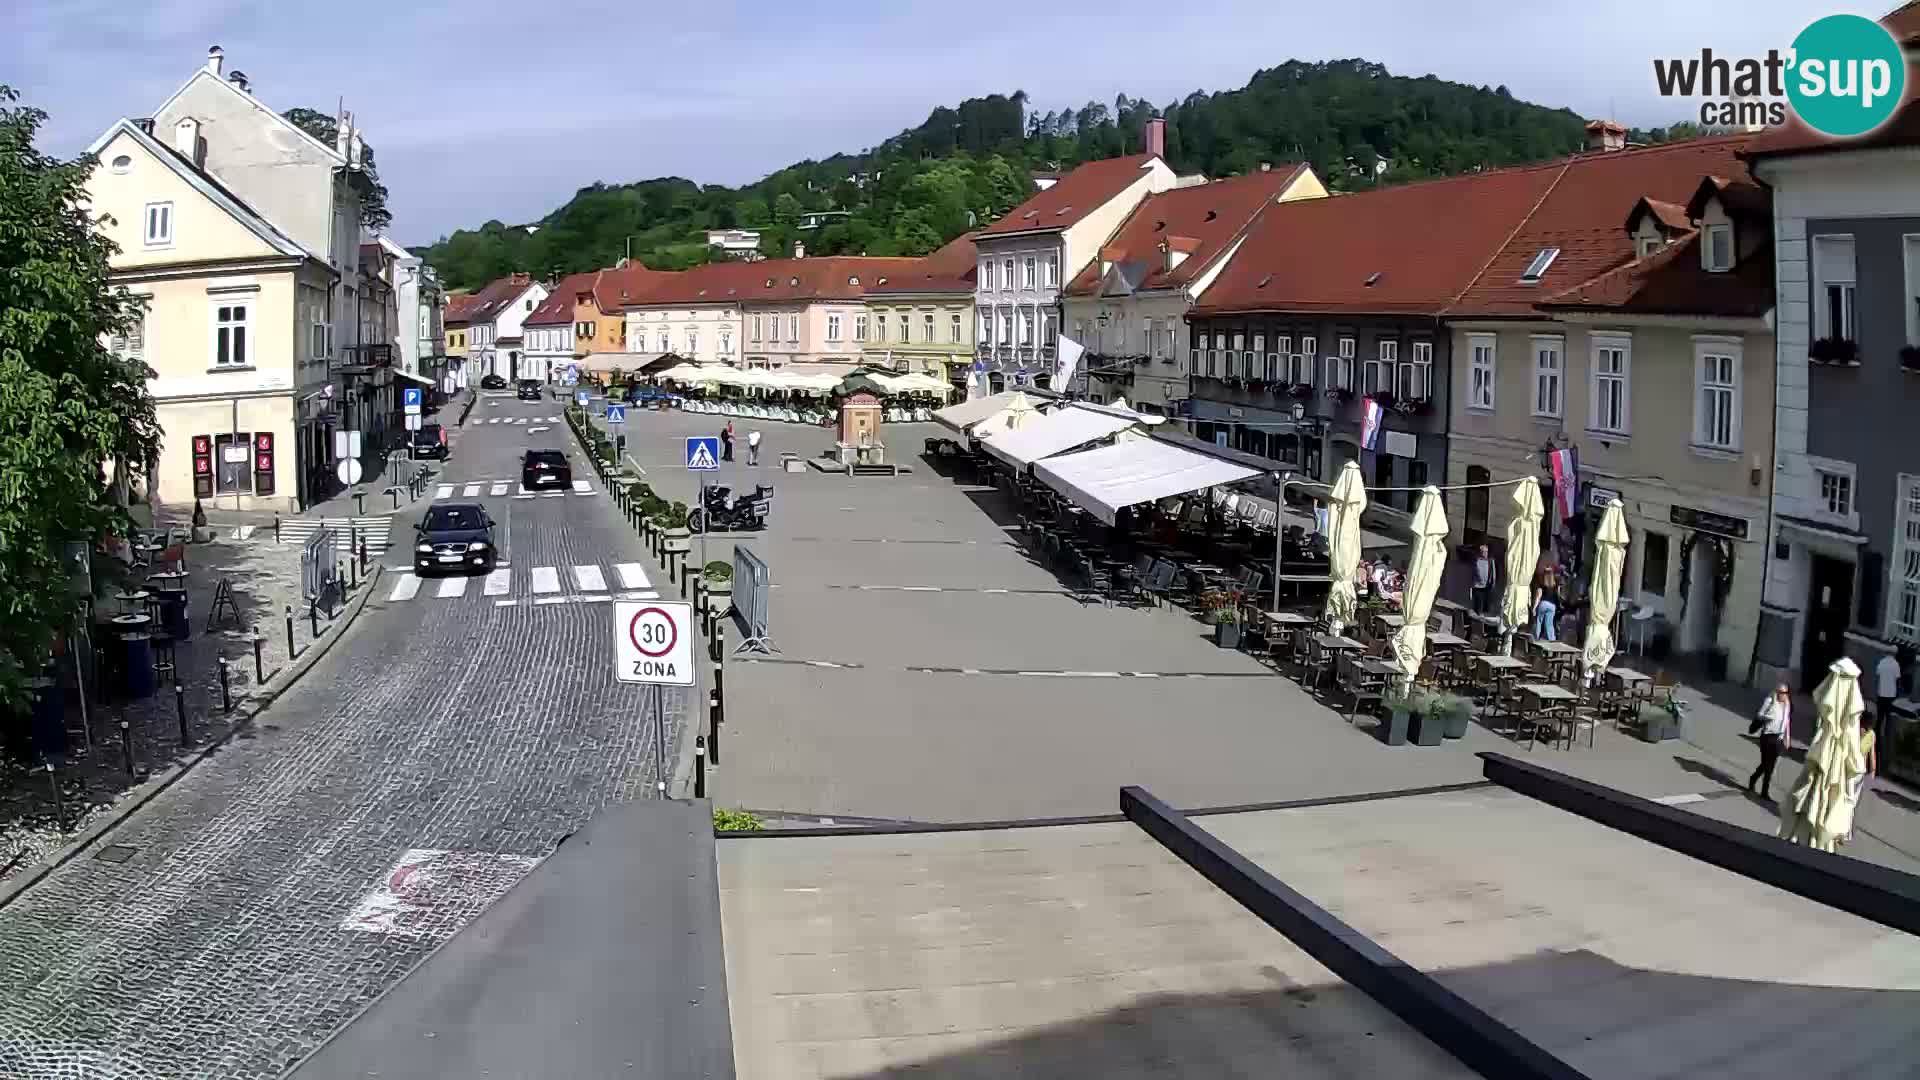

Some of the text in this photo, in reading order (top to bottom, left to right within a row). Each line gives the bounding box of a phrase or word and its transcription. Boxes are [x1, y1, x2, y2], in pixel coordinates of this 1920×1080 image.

[408, 391, 417, 403] P
[642, 623, 666, 645] 30
[632, 660, 677, 677] ZONA
